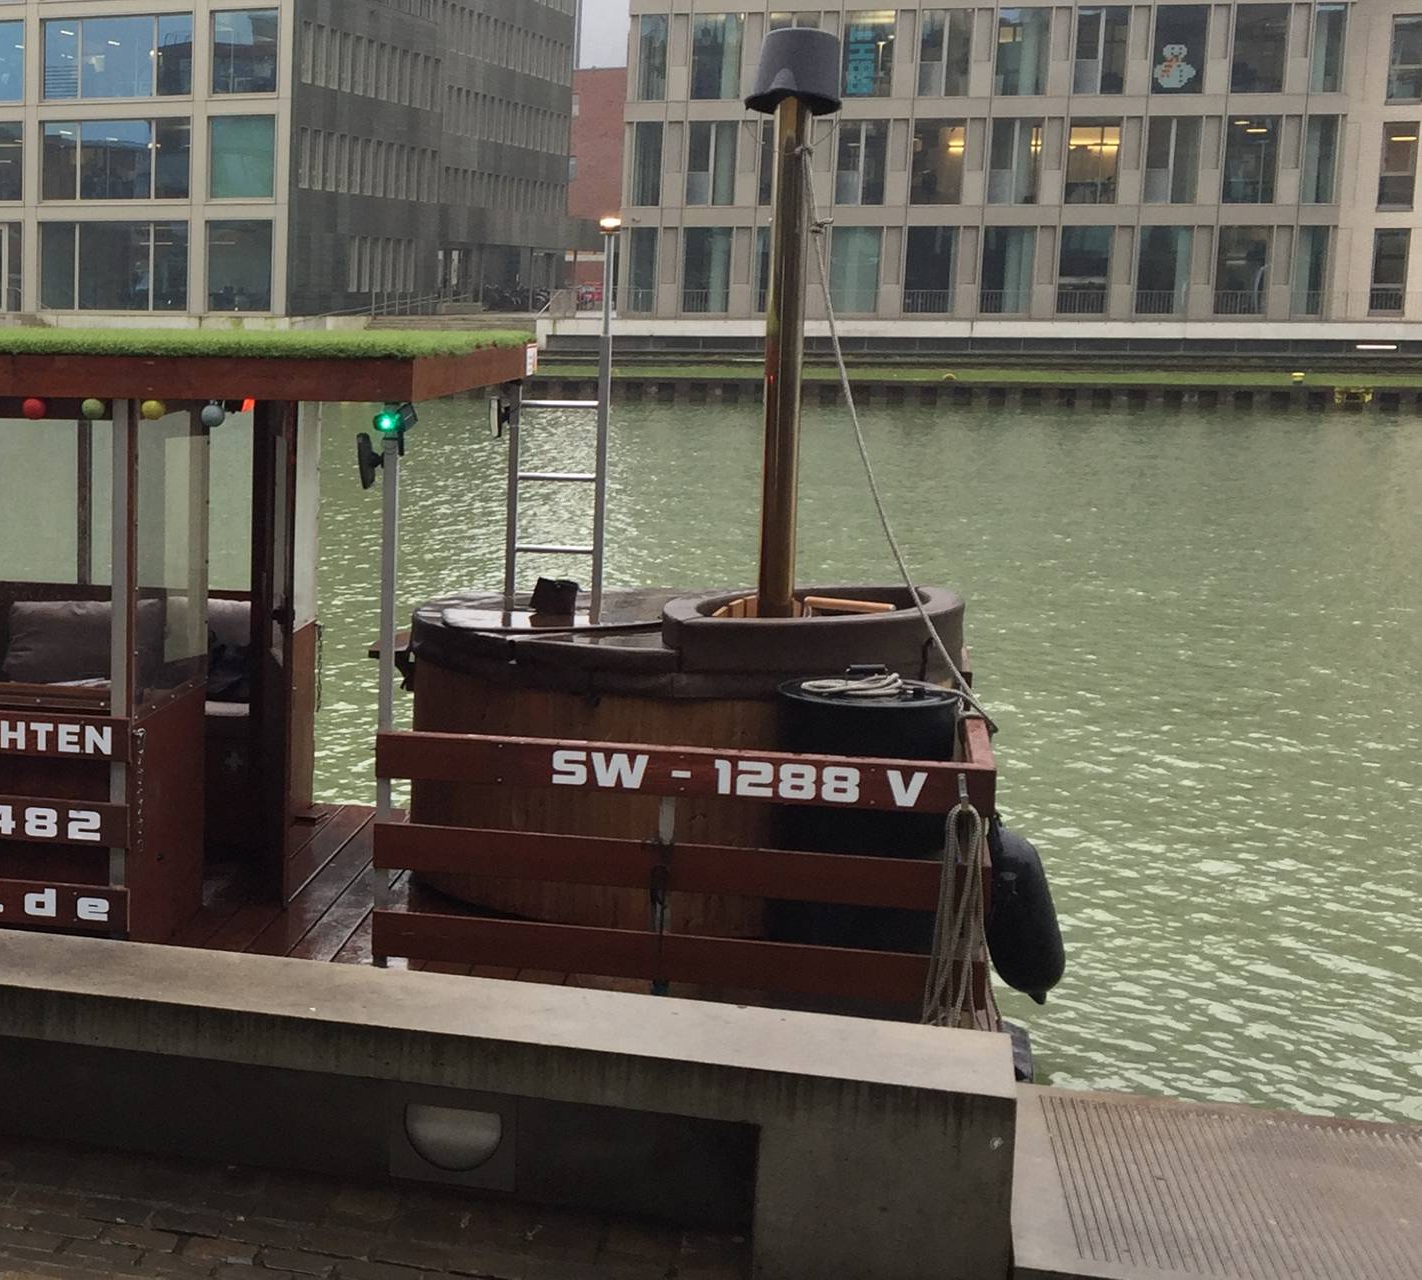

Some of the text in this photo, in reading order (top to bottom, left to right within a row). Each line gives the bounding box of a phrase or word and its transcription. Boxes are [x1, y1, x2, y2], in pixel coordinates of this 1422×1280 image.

[552, 750, 649, 789] SW
[714, 759, 860, 803] 1288
[886, 770, 928, 807] V
